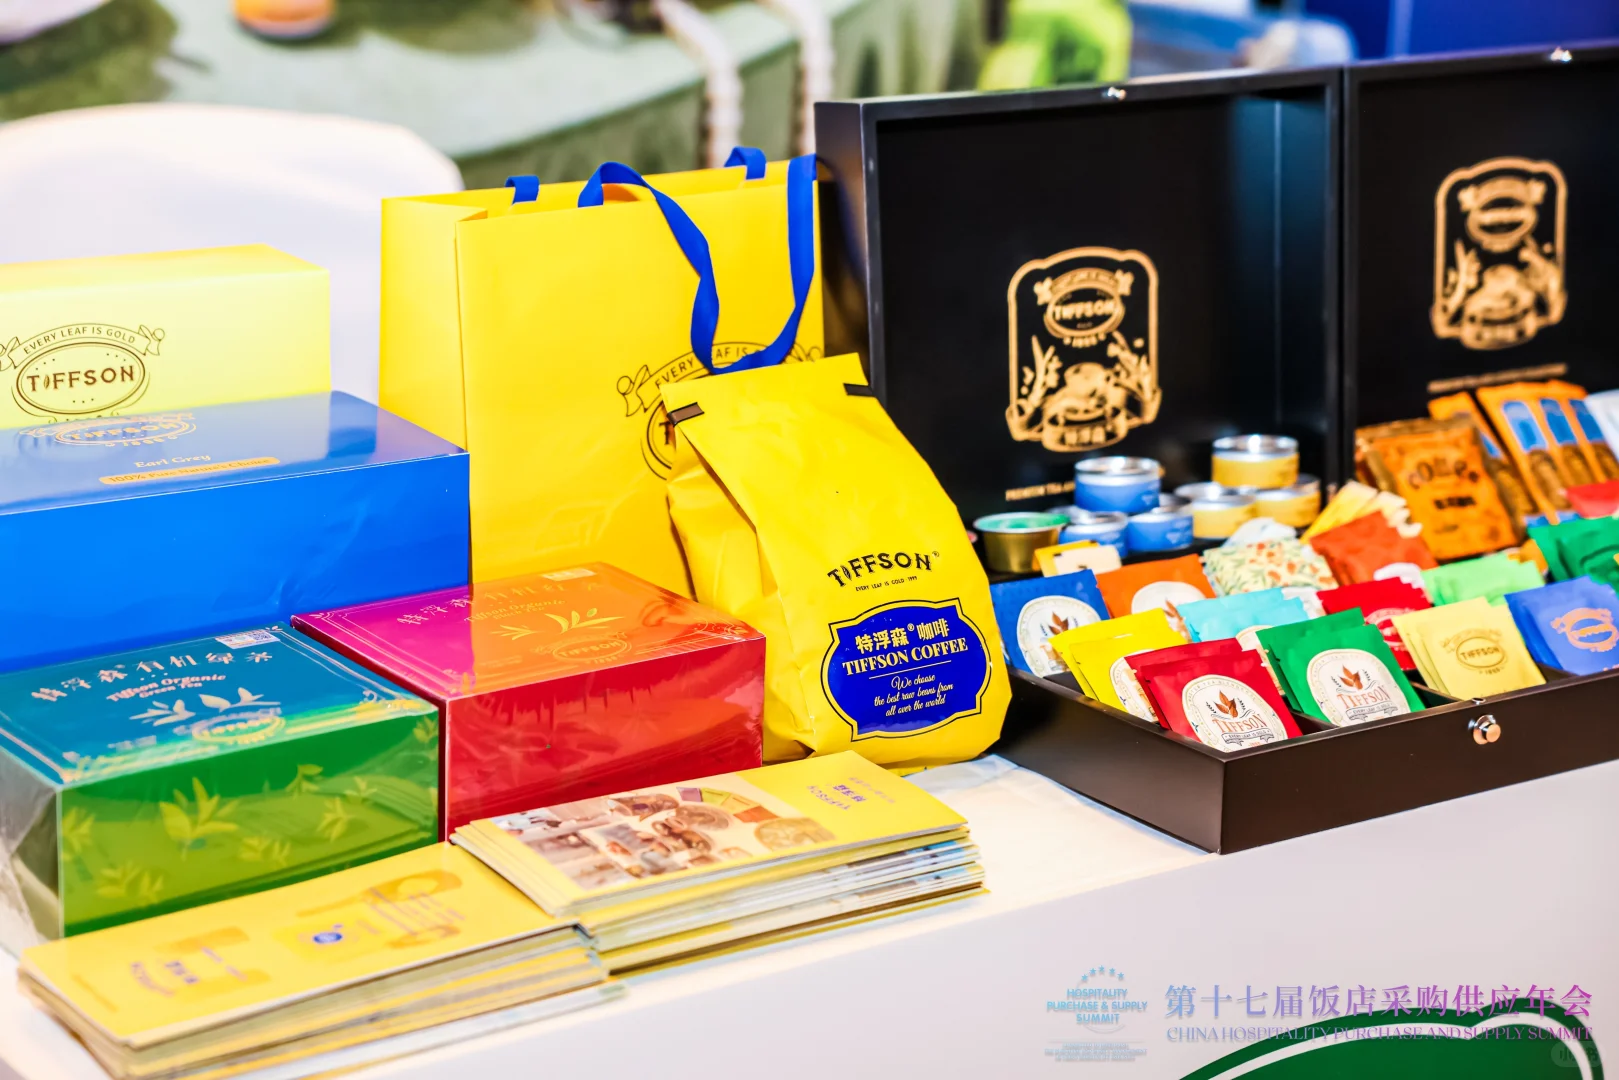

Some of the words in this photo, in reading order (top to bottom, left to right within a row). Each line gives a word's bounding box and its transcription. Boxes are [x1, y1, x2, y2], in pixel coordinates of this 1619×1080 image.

[23, 332, 57, 354] EVERY
[60, 326, 88, 338] LEAF
[106, 328, 136, 344] GOLD
[26, 365, 135, 392] TIFFSON
[654, 357, 694, 389] EVERY
[134, 458, 168, 468] Earl
[172, 454, 211, 464] Grey
[108, 474, 147, 483] 100%
[916, 618, 950, 642] 咖啡
[842, 649, 909, 676] TIFFSON
[910, 637, 968, 661] COFFEE
[874, 696, 885, 706] the
[886, 692, 900, 703] best
[901, 691, 915, 700] raw
[917, 686, 936, 697] beans
[936, 682, 954, 698] from
[891, 676, 912, 690] We
[914, 674, 936, 685] choose
[885, 705, 896, 716] all
[897, 704, 912, 713] over
[913, 700, 923, 710] the
[925, 694, 946, 707] world
[1336, 685, 1391, 709] TIFFSON
[1212, 714, 1267, 733] TIFFSON
